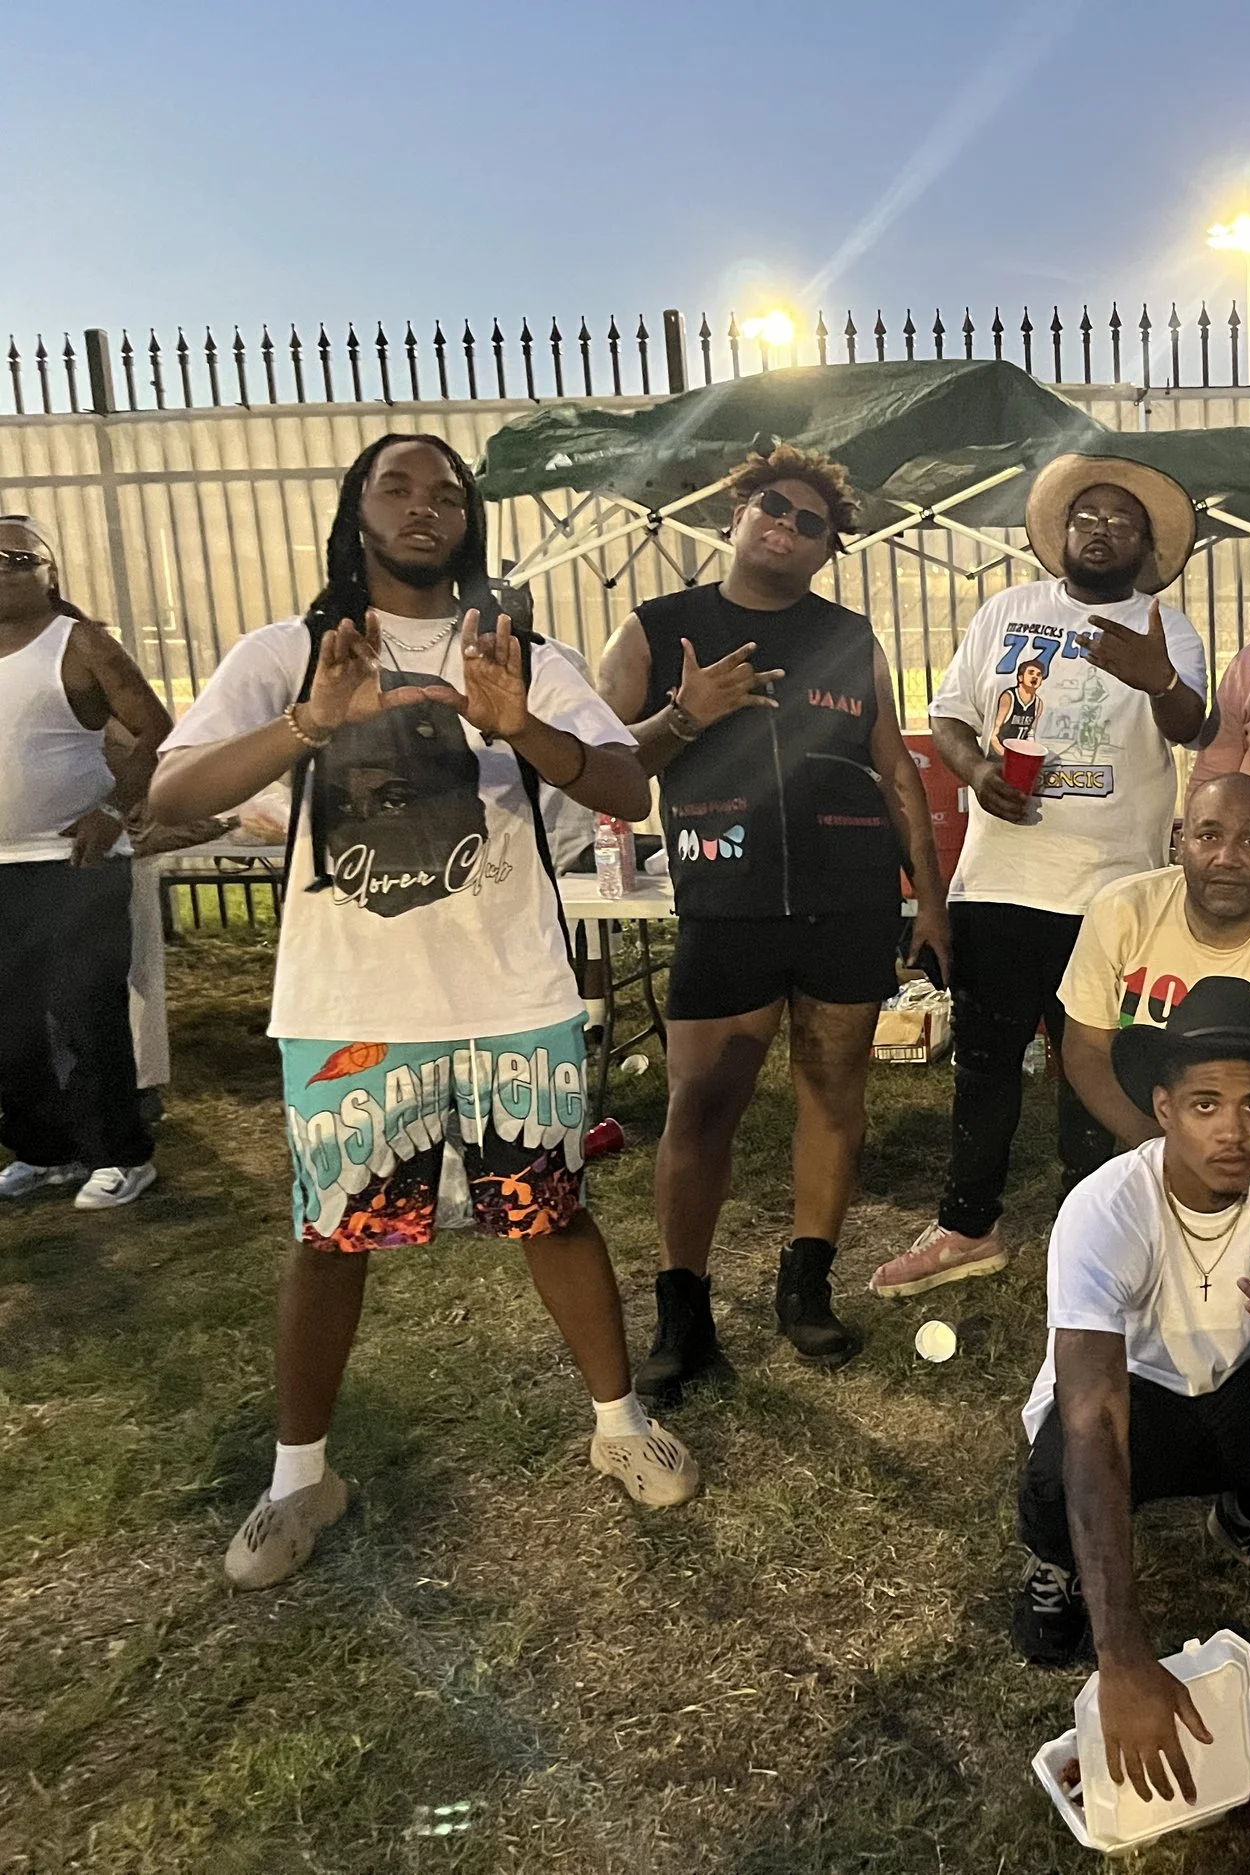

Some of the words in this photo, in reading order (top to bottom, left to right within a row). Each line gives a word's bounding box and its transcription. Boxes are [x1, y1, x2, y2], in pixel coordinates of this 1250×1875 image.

[996, 633, 1062, 680] 77
[332, 844, 436, 908] Clover
[444, 833, 513, 896] Club
[384, 1047, 586, 1145] Angele
